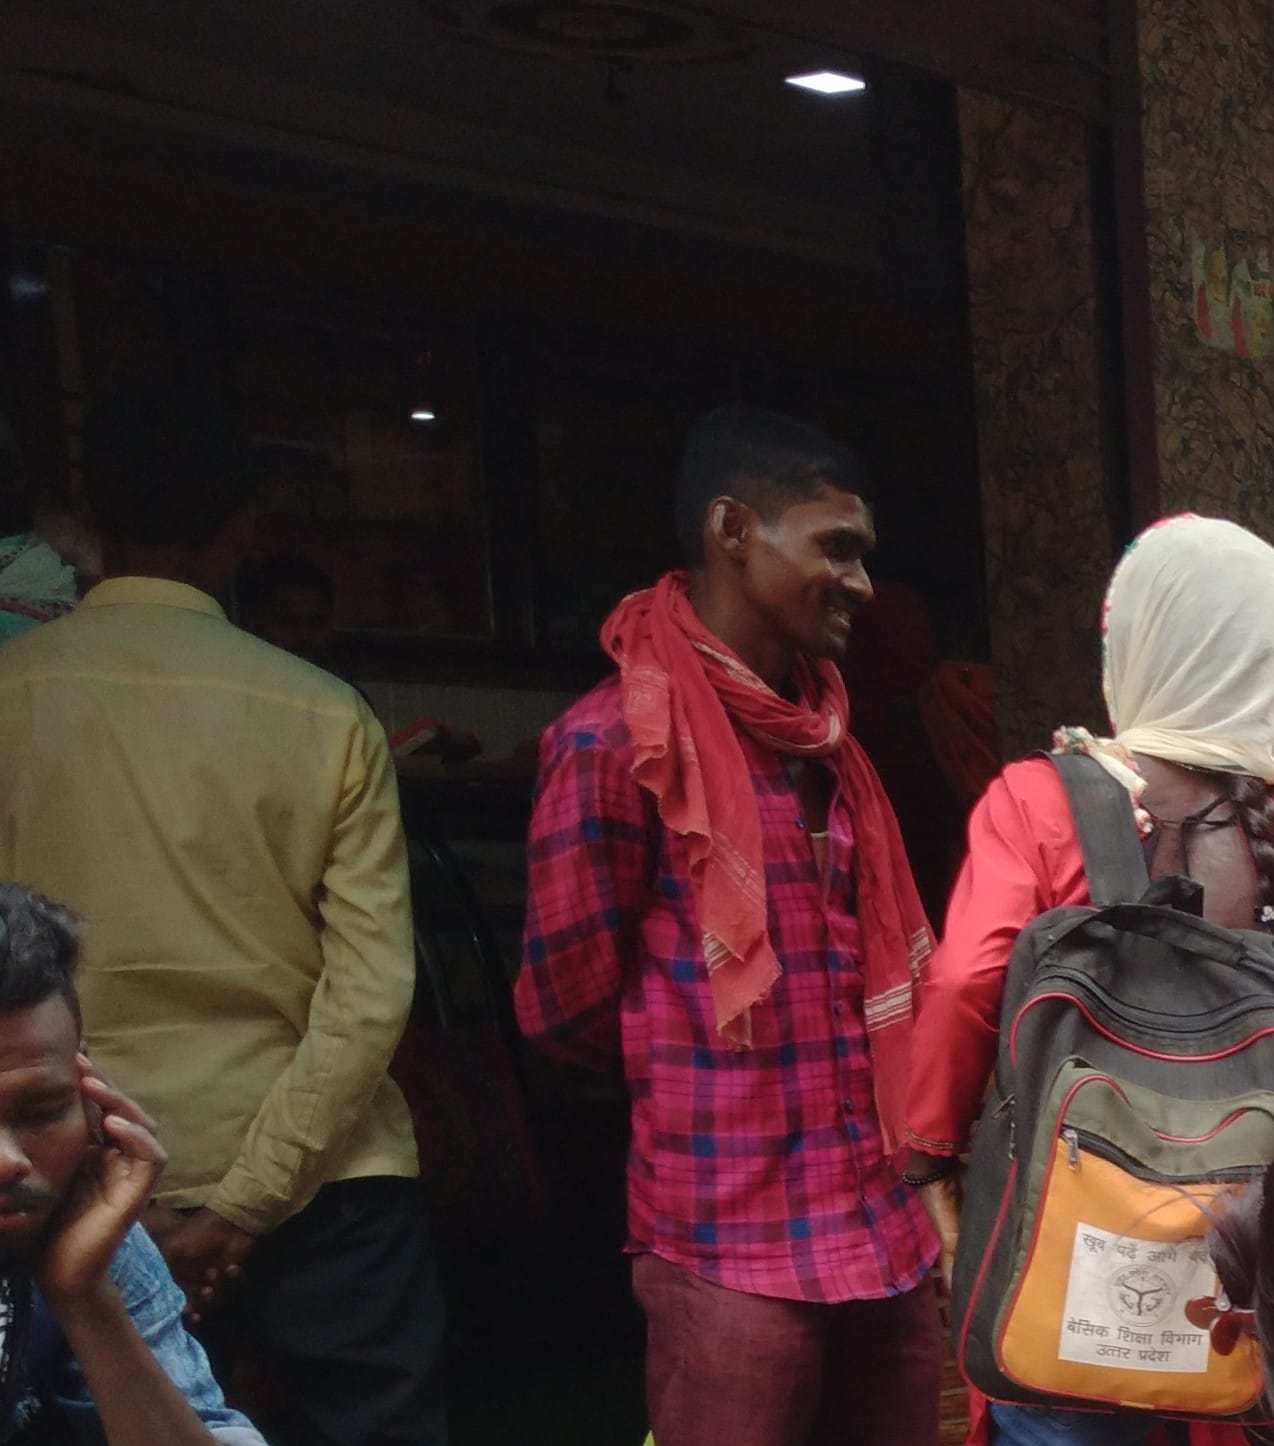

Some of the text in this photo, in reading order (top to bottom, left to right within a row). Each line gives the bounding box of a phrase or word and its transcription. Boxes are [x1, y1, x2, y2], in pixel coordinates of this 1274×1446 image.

[1066, 1316, 1204, 1346] बेसिक शिक्षा विभाग
[1138, 1347, 1172, 1362] प्रदेश
